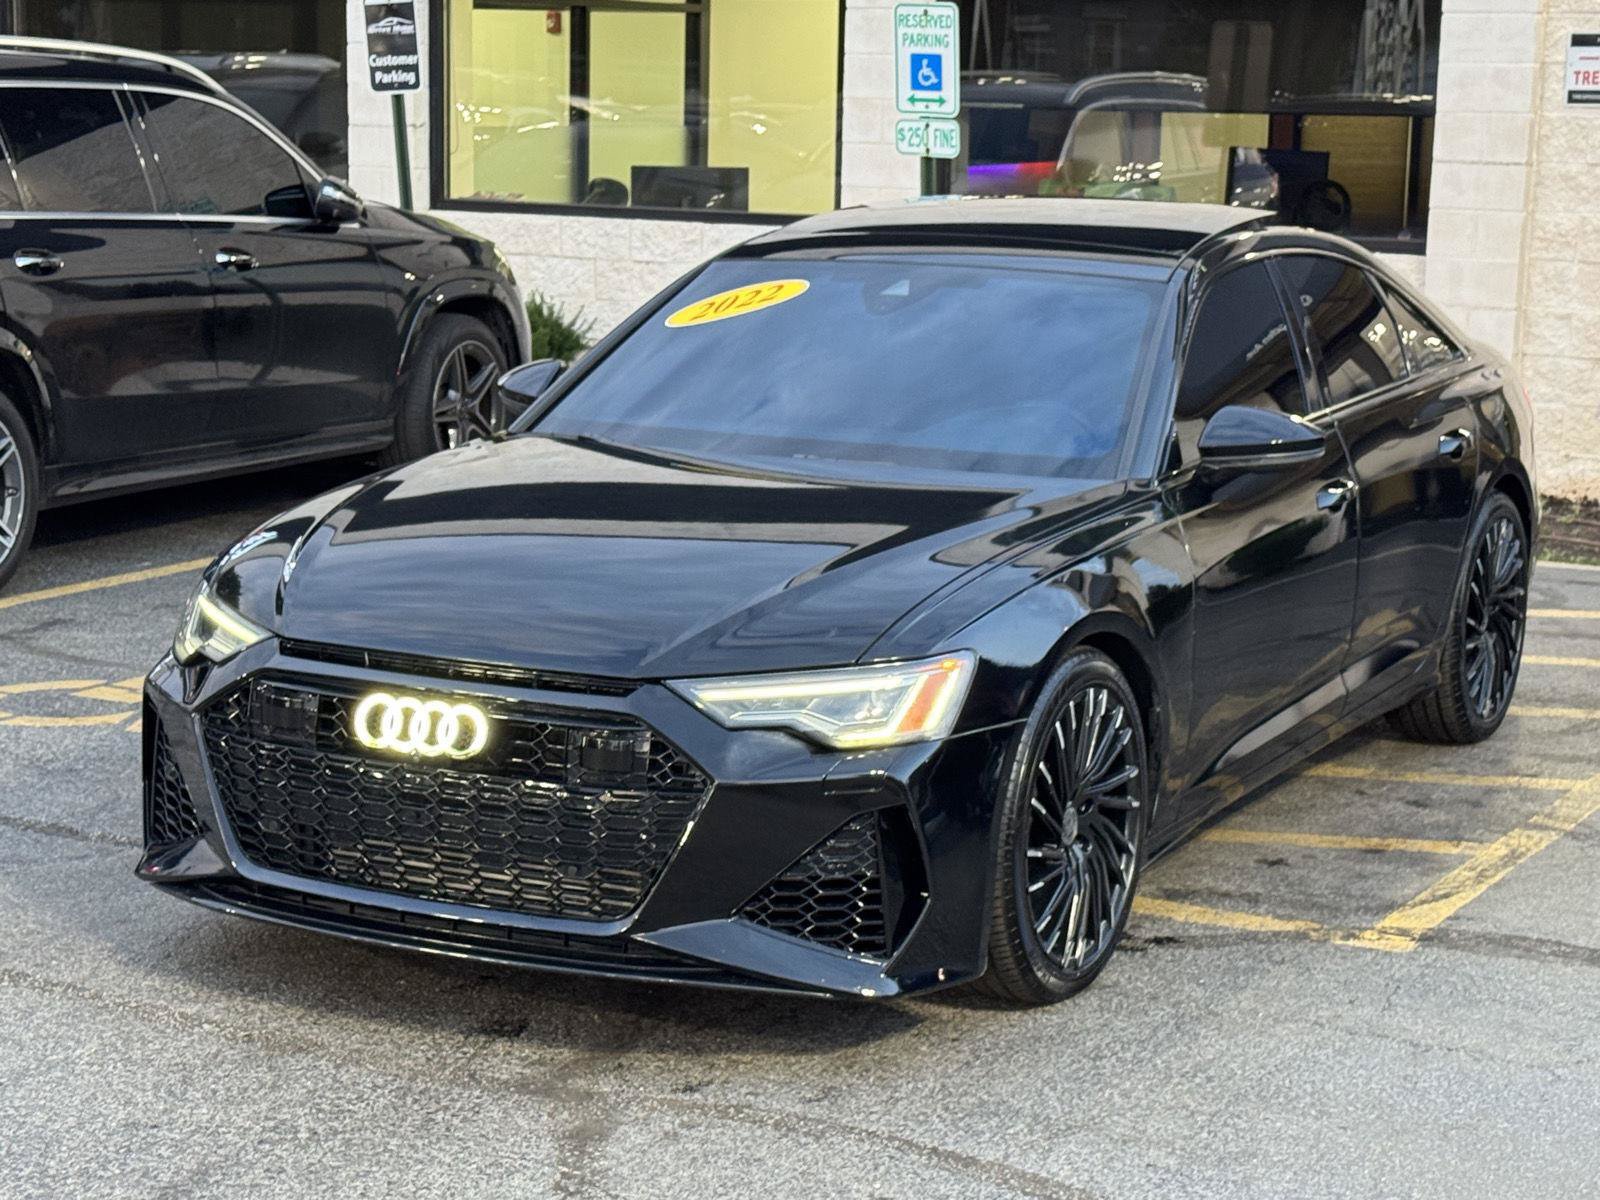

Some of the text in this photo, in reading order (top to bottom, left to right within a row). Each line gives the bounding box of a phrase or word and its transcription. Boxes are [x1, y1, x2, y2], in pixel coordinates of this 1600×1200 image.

[898, 13, 952, 28] RESERVED
[902, 32, 949, 48] PARKING
[369, 54, 418, 67] Customer
[375, 69, 416, 85] Parking
[934, 128, 956, 148] FINE
[689, 284, 784, 321] 2022
